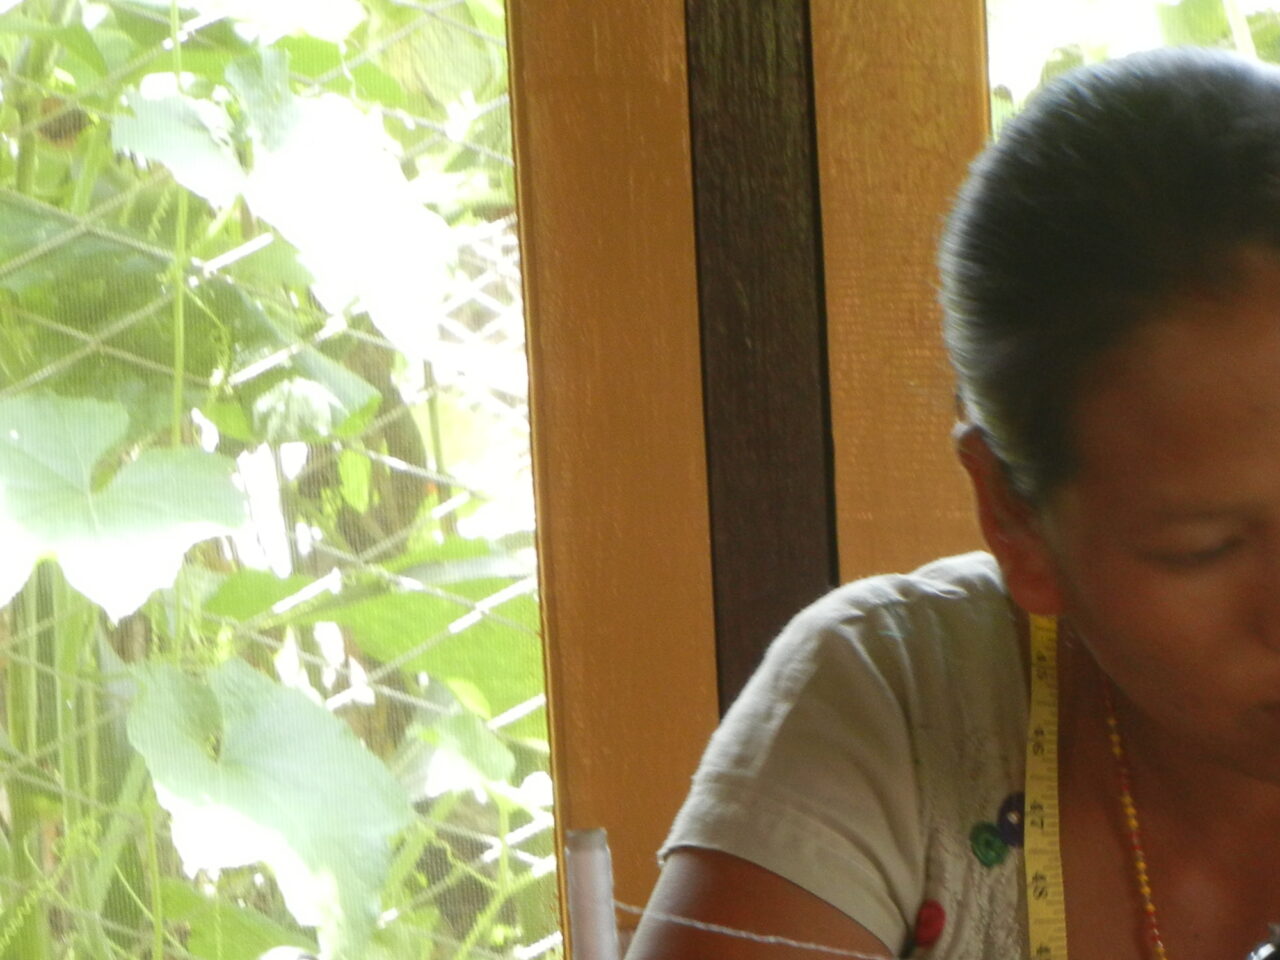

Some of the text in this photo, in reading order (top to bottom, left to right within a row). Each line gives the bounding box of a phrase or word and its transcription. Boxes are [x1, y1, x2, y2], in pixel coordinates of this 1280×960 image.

[1033, 727, 1045, 756] 46
[1029, 801, 1044, 830] 47
[1032, 870, 1048, 900] 48
